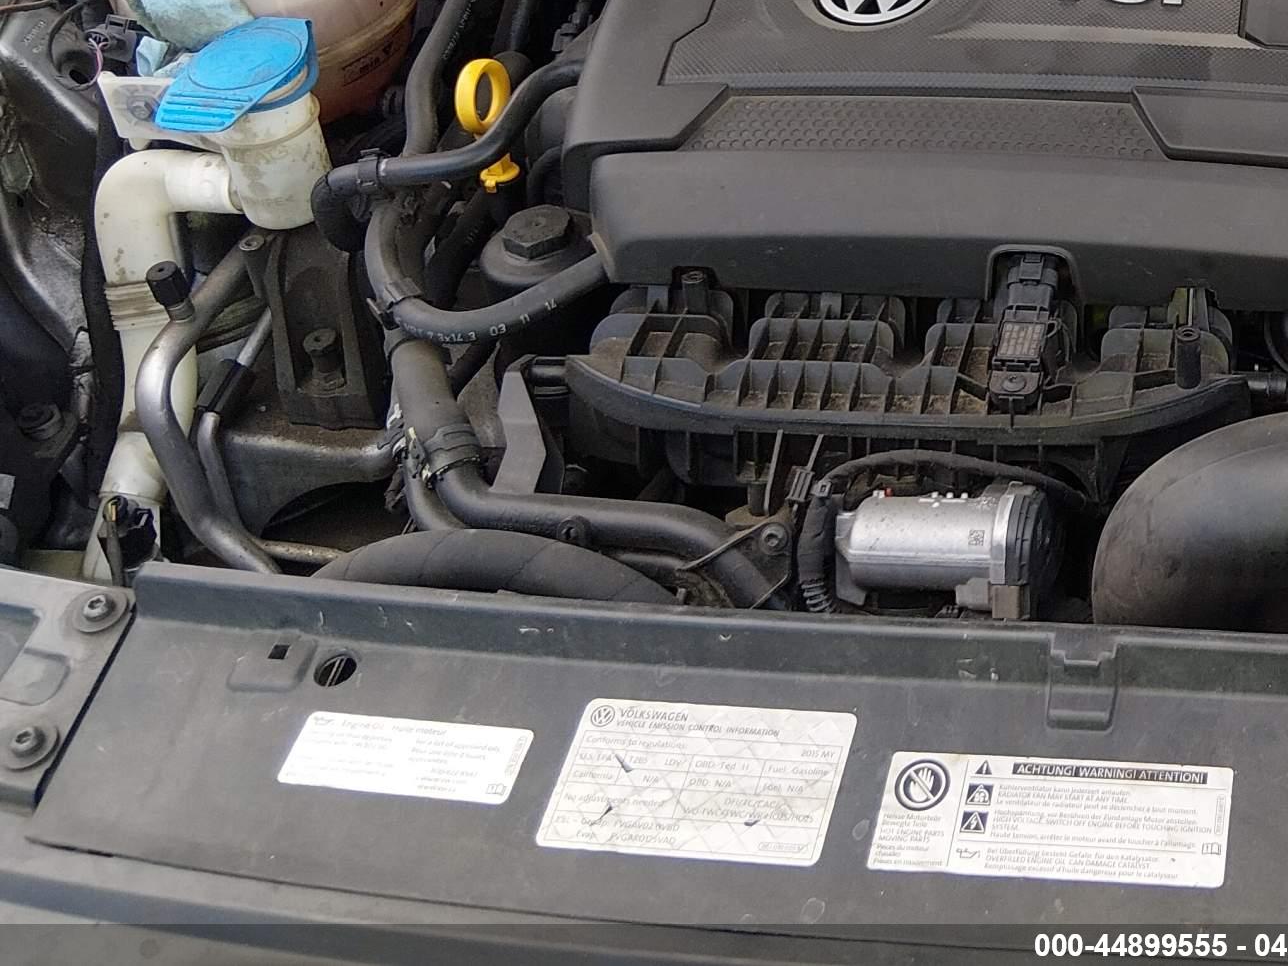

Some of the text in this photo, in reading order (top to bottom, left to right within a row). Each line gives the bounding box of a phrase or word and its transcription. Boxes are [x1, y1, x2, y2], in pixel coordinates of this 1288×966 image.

[489, 324, 507, 337] 03
[544, 298, 558, 311] 14
[620, 708, 689, 722] VOLKSWAGEN
[617, 720, 781, 737] VEHICLE EMISSION CONTROL INFORMATION
[586, 735, 626, 745] Conforms
[629, 738, 637, 746] to
[801, 749, 836, 759] 2015 MY
[572, 769, 613, 780] California
[791, 765, 830, 776] Gasoline
[1017, 763, 1204, 784] ACHTUNG! WARNING! ATTENTION!
[642, 774, 660, 785] N/A
[714, 779, 733, 788] N/A
[787, 785, 805, 794] N/A
[1048, 793, 1063, 801] MAY
[1064, 794, 1084, 802] START
[1095, 795, 1110, 803] ANY
[1052, 801, 1082, 809] radiateur
[1083, 803, 1098, 811] peut
[1144, 815, 1166, 824] Motor
[1046, 818, 1073, 827] SWITCH
[1088, 821, 1113, 829] ENGINE
[1114, 821, 1140, 830] BEFORE
[1142, 823, 1179, 832] TOUCHING
[1180, 825, 1212, 834] IGNITION
[881, 827, 945, 837] HOT ENGINE PARTS
[878, 834, 909, 842] MOVING
[986, 855, 1026, 864] OVERFILLED
[1027, 857, 1053, 865] ENGINE
[1054, 858, 1066, 866] OIL
[1068, 859, 1084, 867] CAN
[1085, 860, 1116, 868] DAMAGE
[1118, 870, 1135, 878] pour
